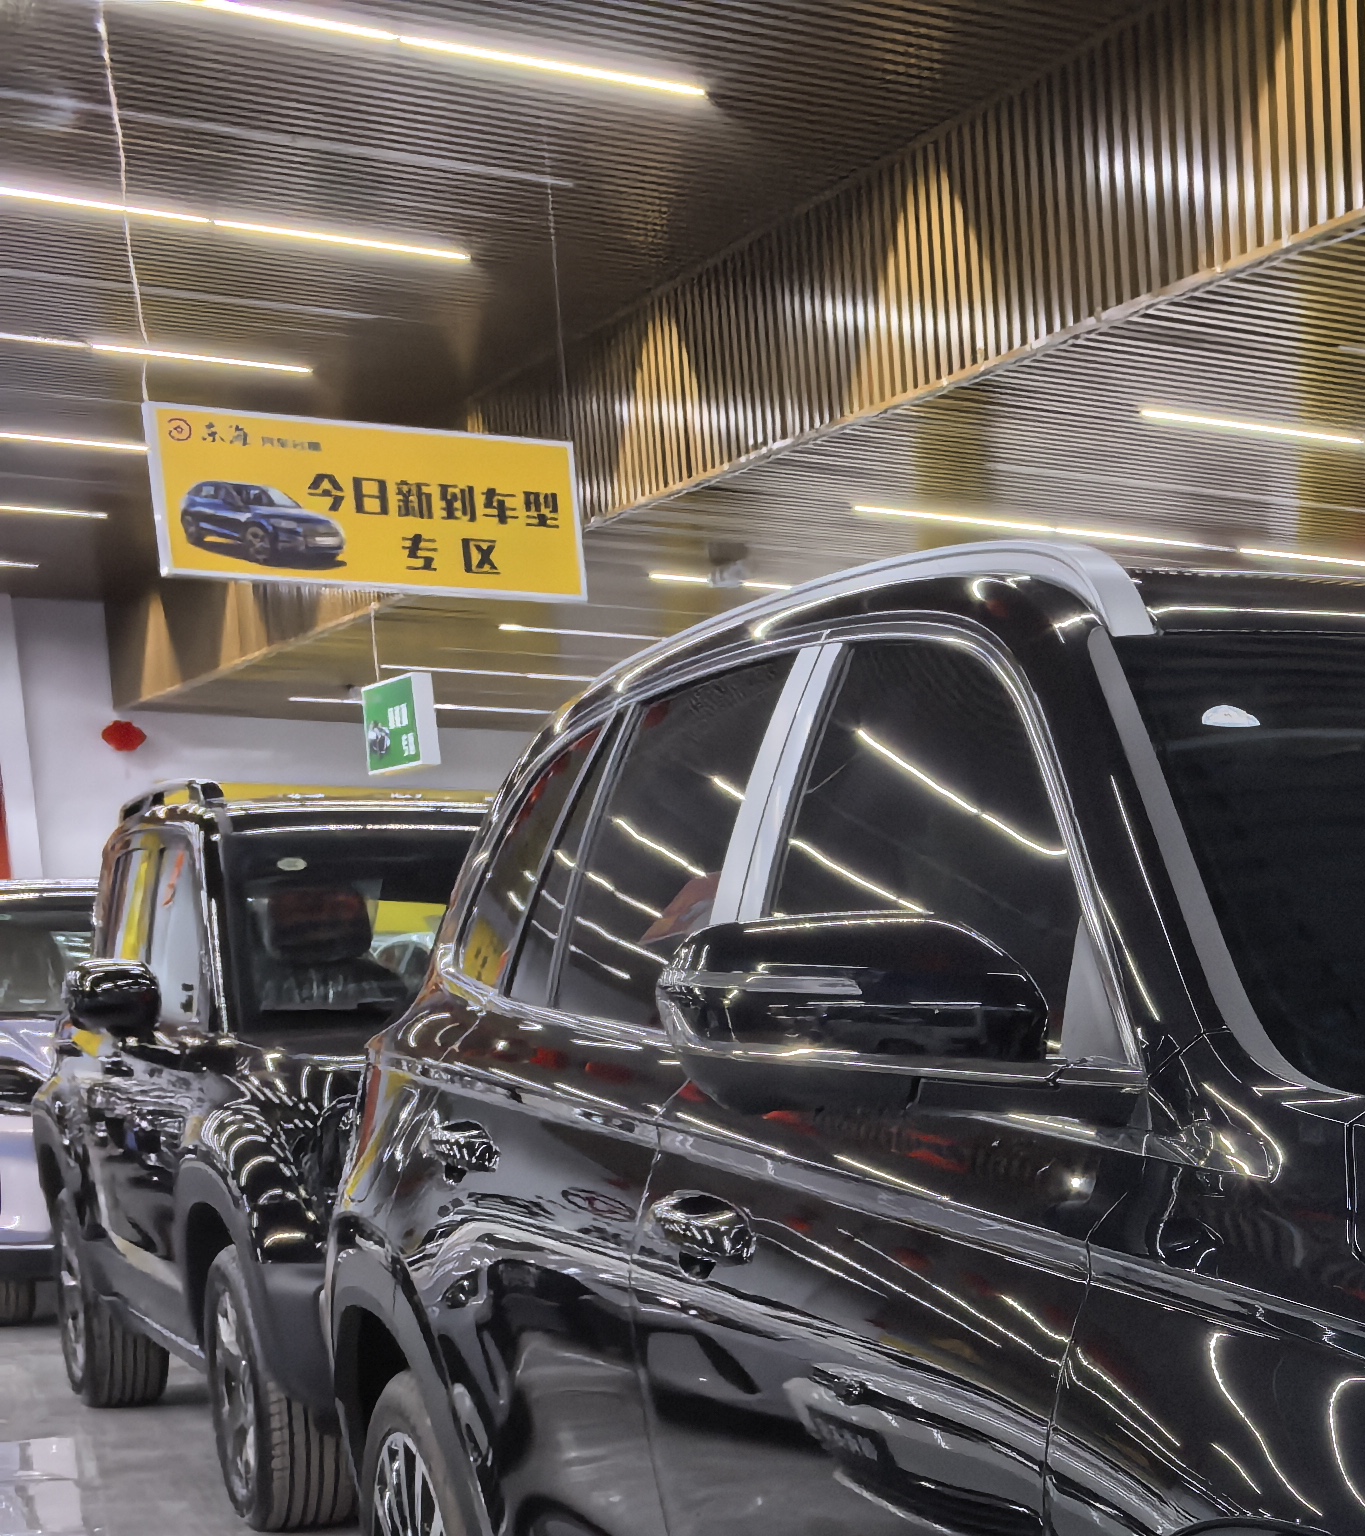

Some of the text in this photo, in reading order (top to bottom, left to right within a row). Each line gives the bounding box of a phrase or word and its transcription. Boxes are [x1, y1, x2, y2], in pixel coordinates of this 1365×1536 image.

[307, 473, 560, 529] 今日新到车型
[401, 533, 501, 575] 专区
